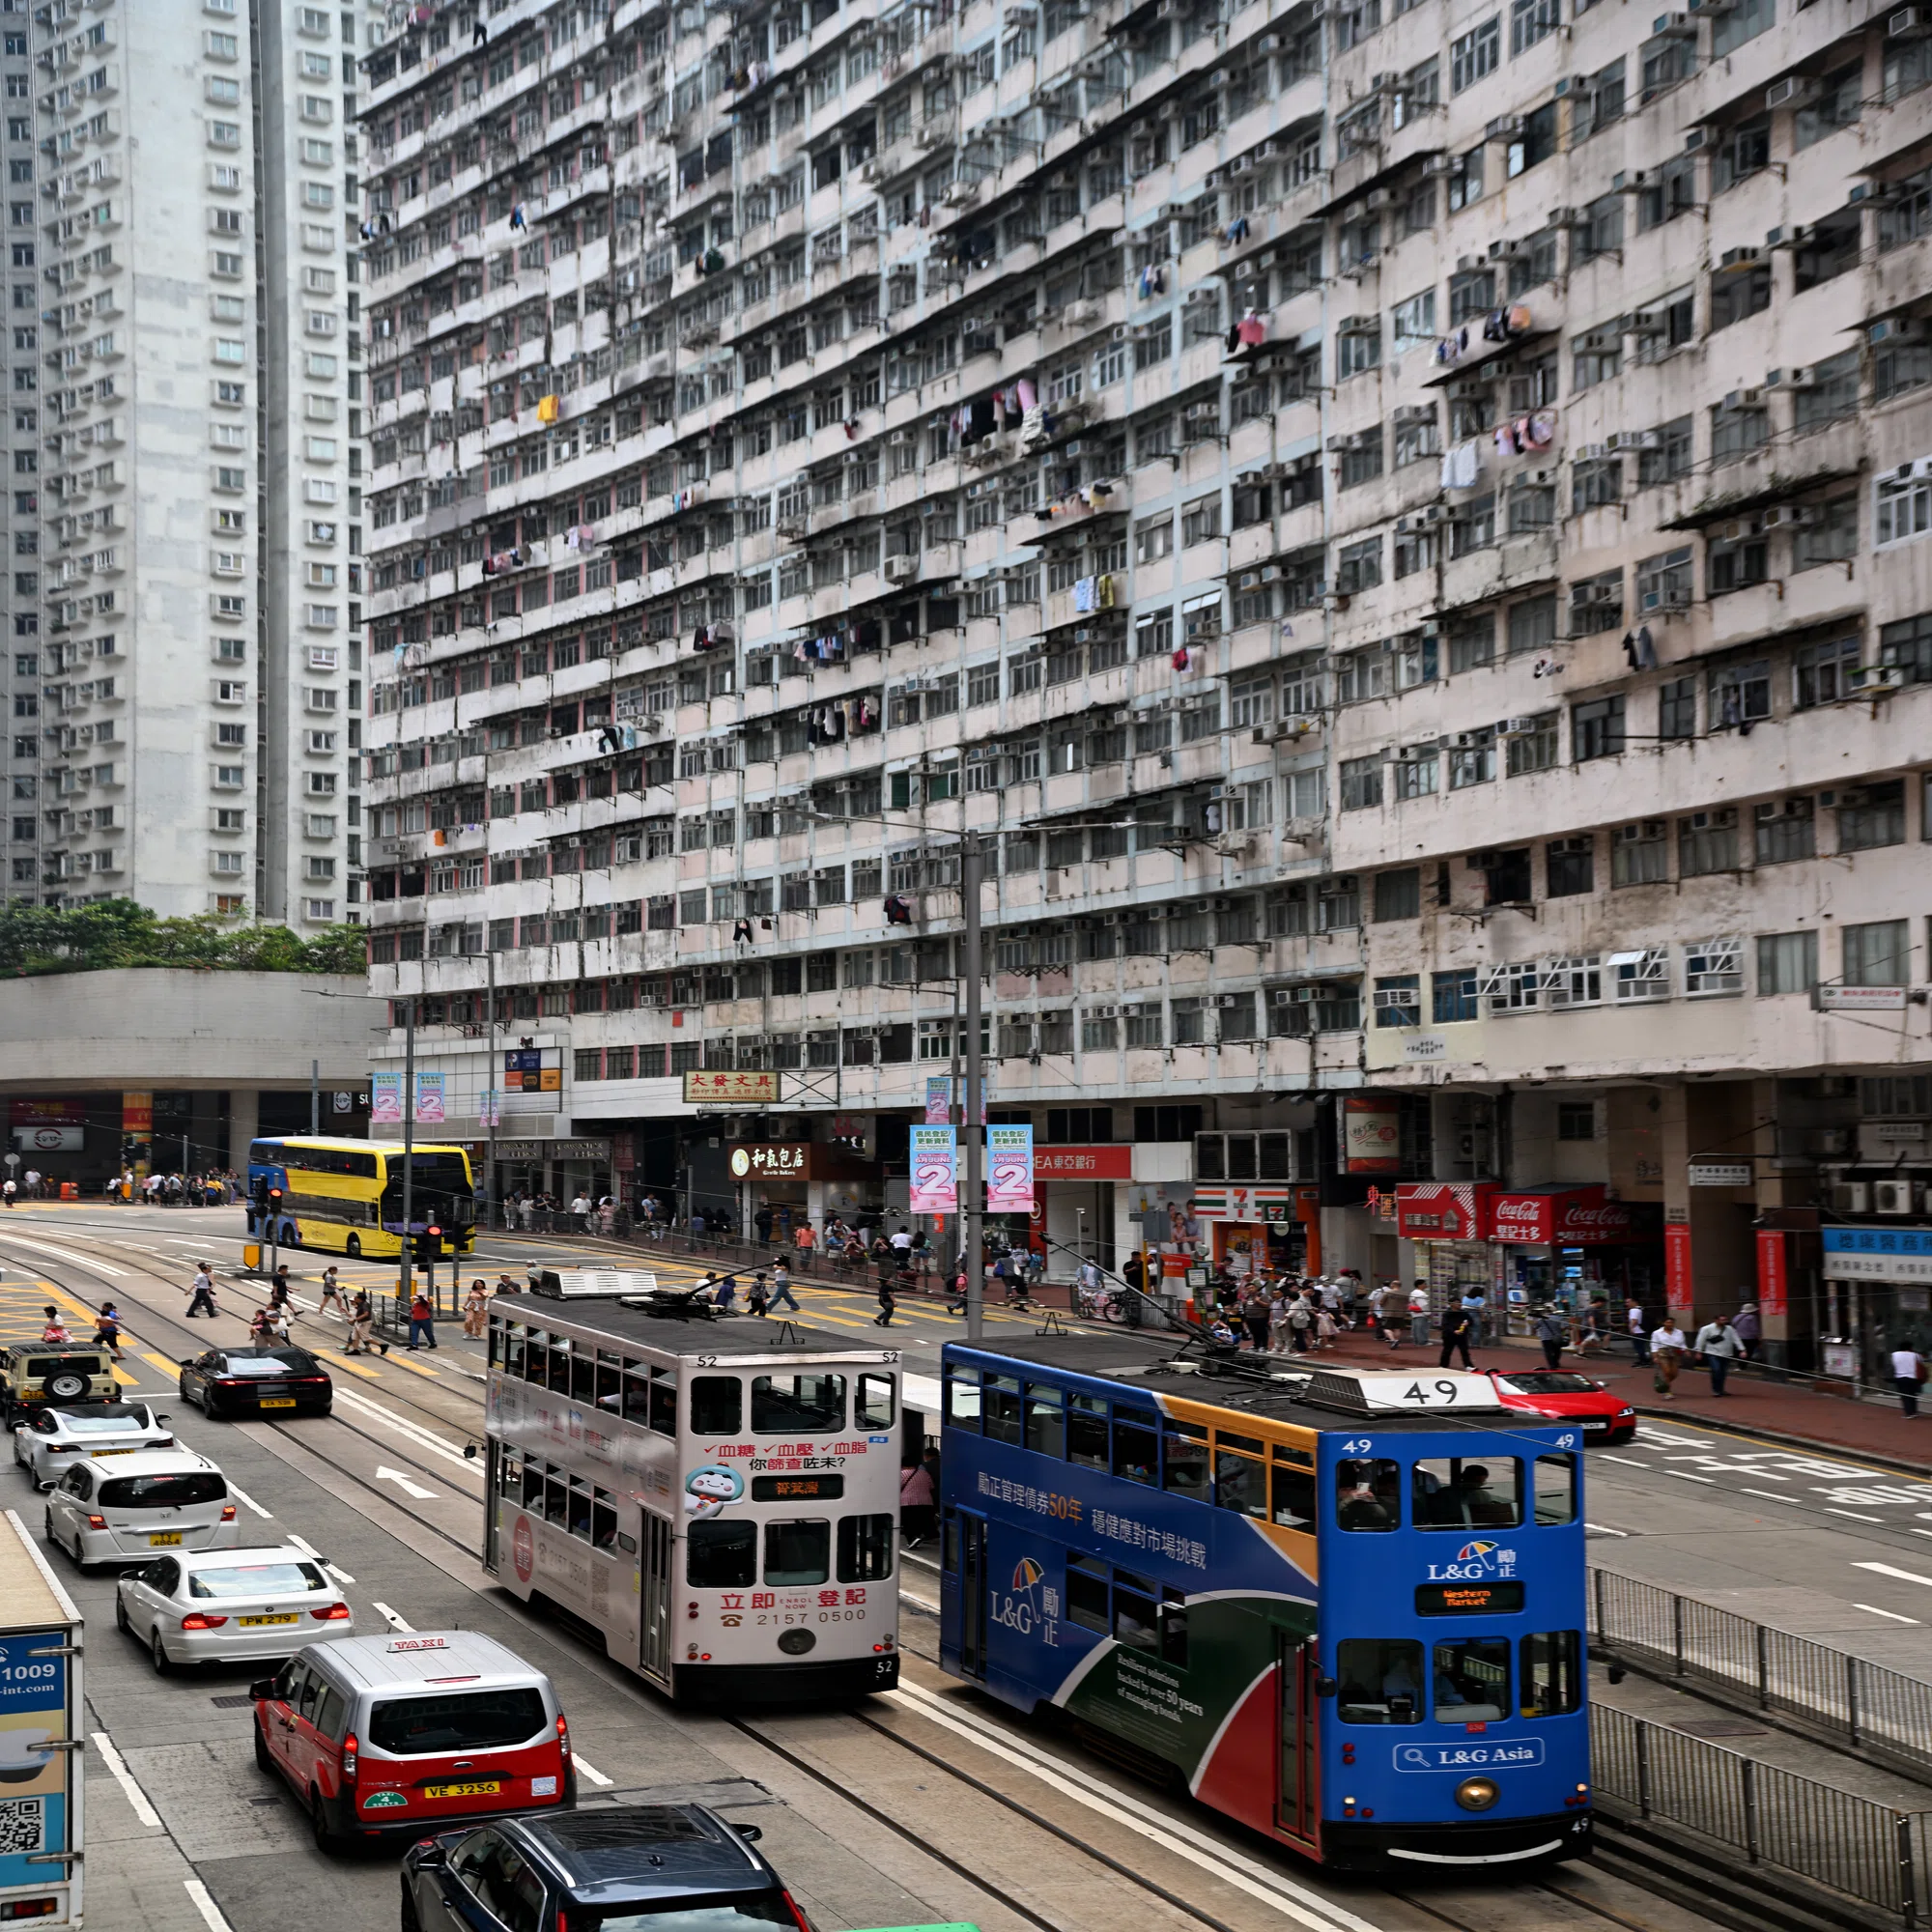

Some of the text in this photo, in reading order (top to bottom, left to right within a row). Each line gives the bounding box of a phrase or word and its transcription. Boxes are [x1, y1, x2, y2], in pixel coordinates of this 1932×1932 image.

[691, 1074, 773, 1087] 大發文具
[376, 1094, 398, 1112] 2
[420, 1094, 441, 1113] 2
[929, 1098, 947, 1115] 2
[752, 1148, 804, 1168] 和氣包店
[1033, 1155, 1095, 1169] EA 東亞銀行
[917, 1164, 951, 1195] 2
[994, 1164, 1028, 1195] 2
[696, 1356, 717, 1367] 52
[883, 1352, 898, 1362] 52
[1403, 1379, 1458, 1405] 49
[718, 1441, 867, 1457] 血糖 血壓 血脂
[1342, 1439, 1373, 1453] 49
[1554, 1434, 1575, 1449] 49
[749, 1457, 846, 1470] 你篩查咗未?
[1092, 1508, 1207, 1570] 穩健應對市場挑戰
[1427, 1564, 1485, 1579] L&G
[721, 1588, 867, 1609] 立即 登記
[1446, 1597, 1487, 1606] Market
[246, 1614, 291, 1625] PW 279
[757, 1609, 866, 1625] 2157 0500
[990, 1590, 1032, 1634] L&G
[395, 1638, 444, 1649] TAXI
[2, 1663, 55, 1680] 1009
[877, 1662, 893, 1673] 52
[1150, 1687, 1166, 1700] over
[1166, 1690, 1179, 1705] 50
[1179, 1697, 1204, 1717] years
[1438, 1747, 1534, 1764] L&G Asia
[430, 1783, 495, 1797] VE 3256
[1571, 1818, 1589, 1833] 49
